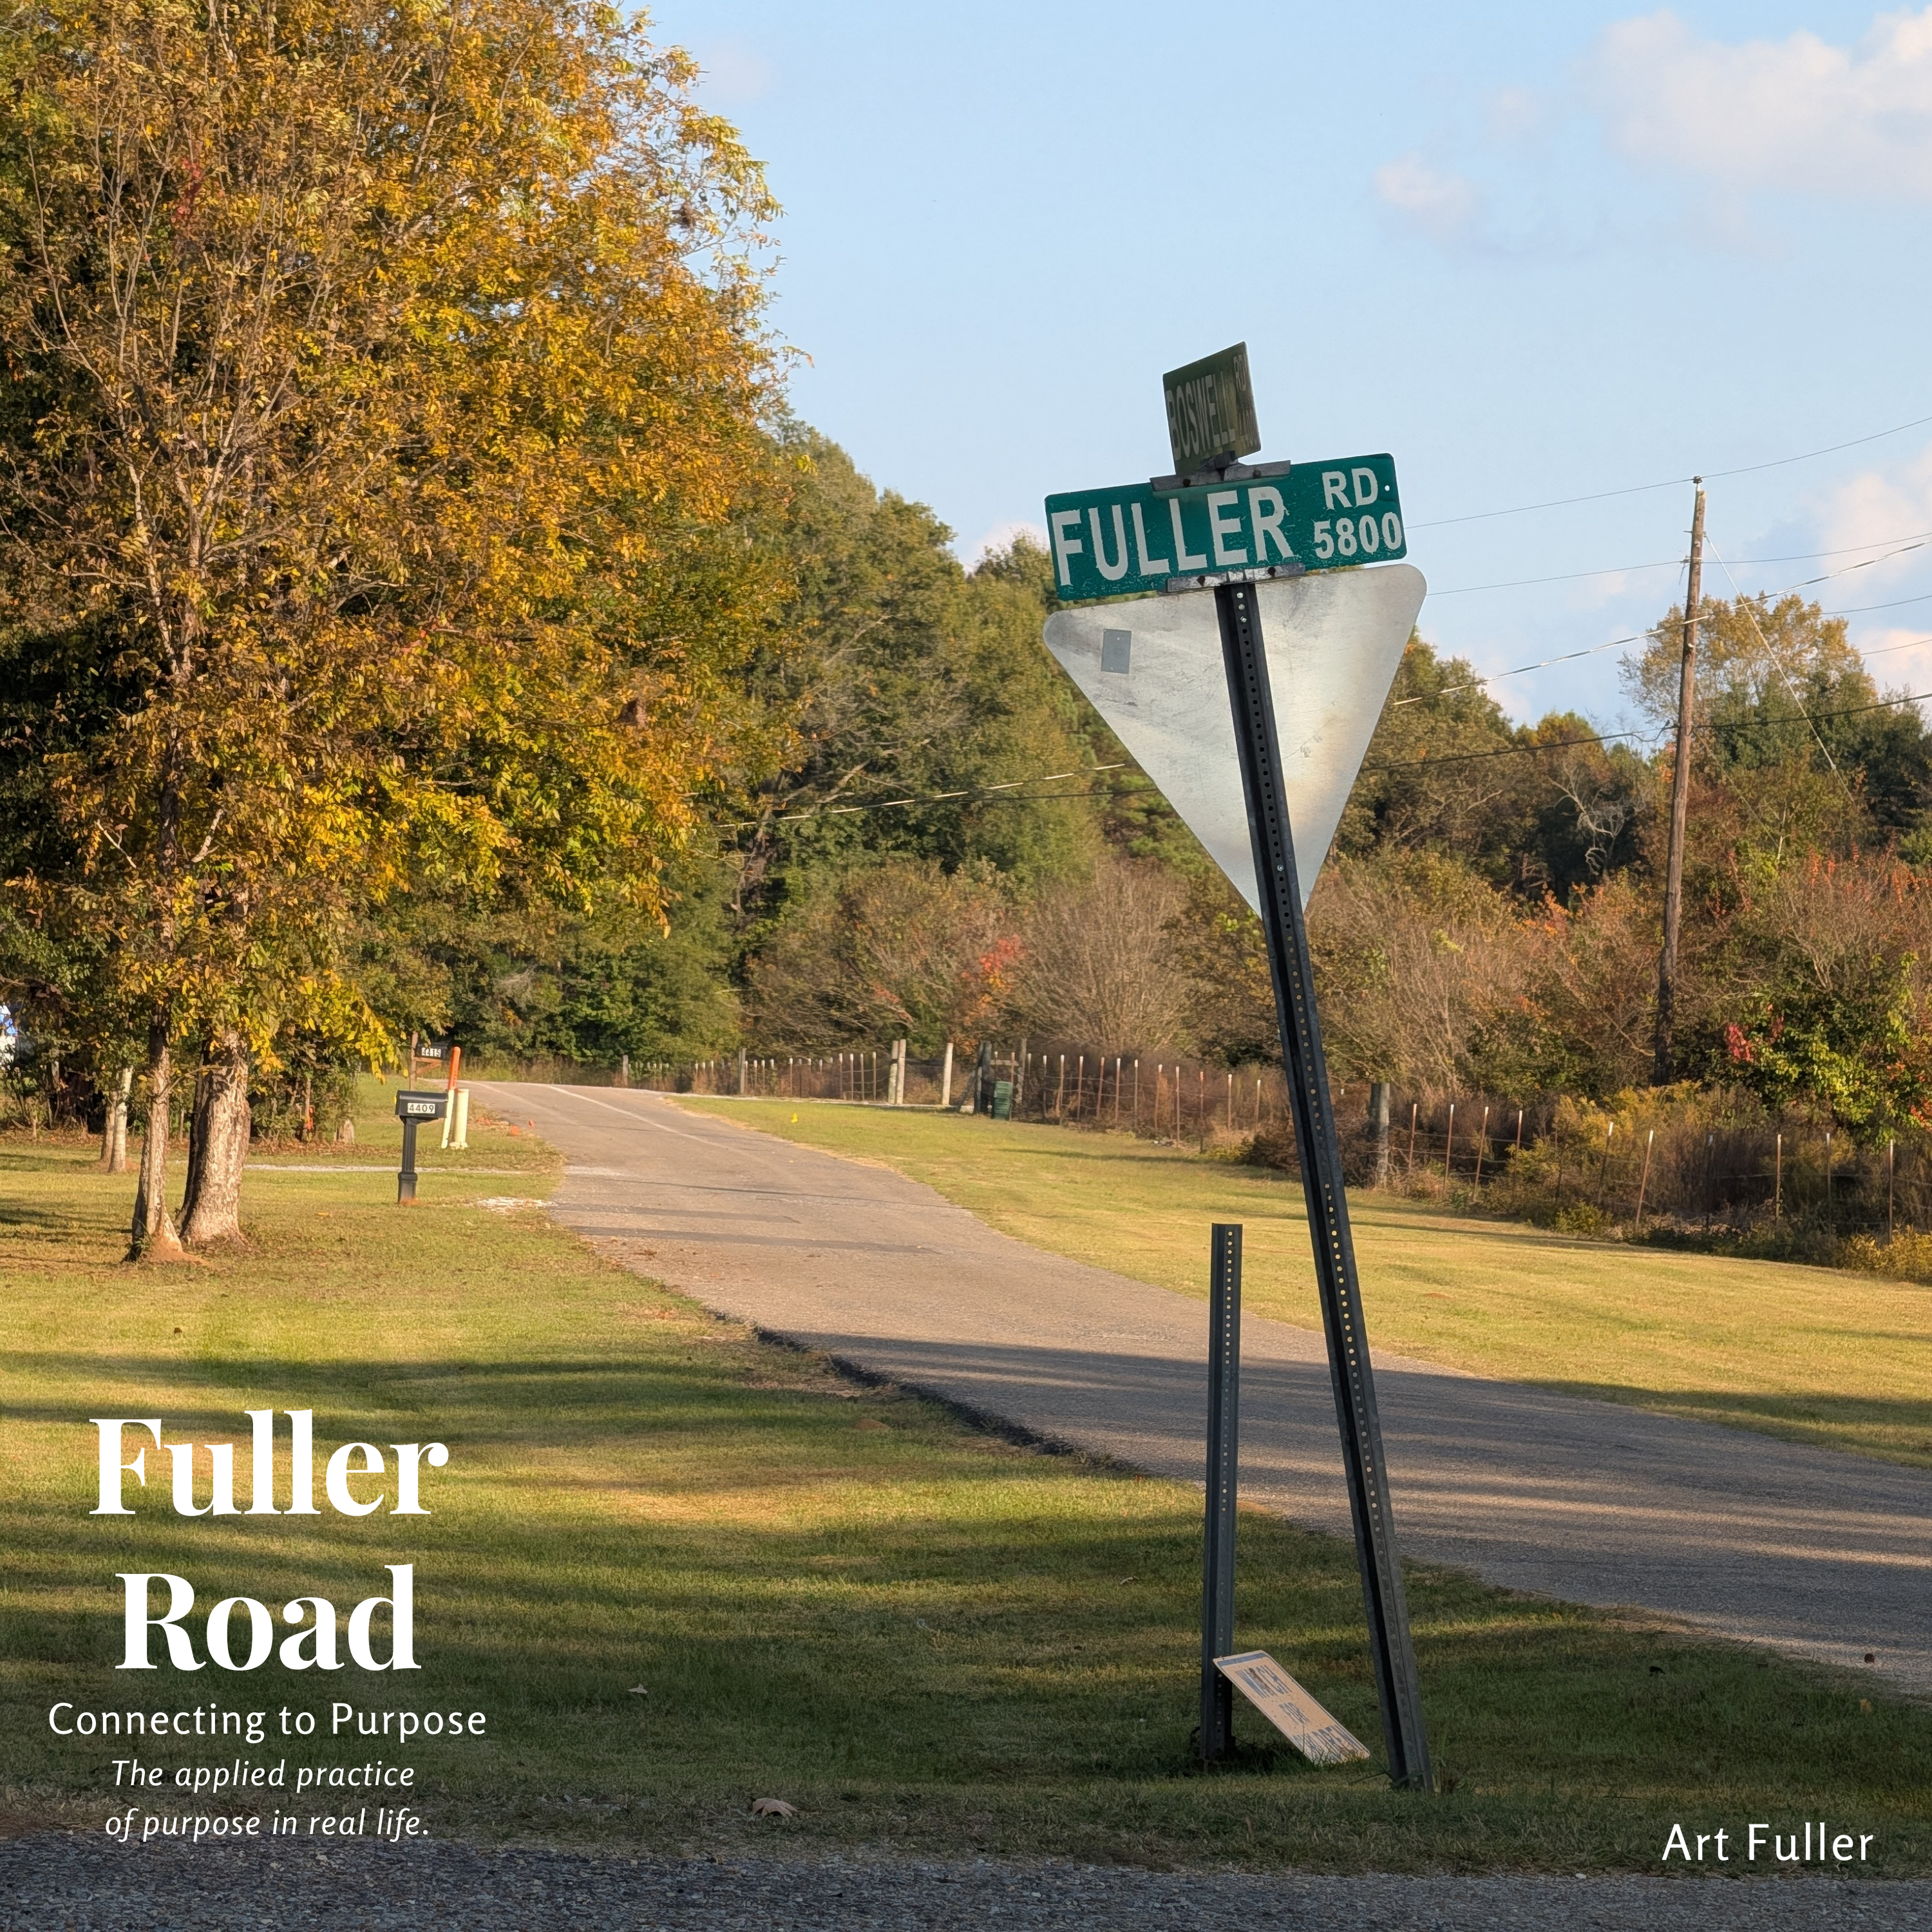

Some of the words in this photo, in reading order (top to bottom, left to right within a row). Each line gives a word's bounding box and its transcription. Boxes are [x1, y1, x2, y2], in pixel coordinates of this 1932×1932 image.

[1166, 371, 1236, 460] BOSWELL
[1233, 354, 1247, 392] RD
[1051, 486, 1294, 586] FULLER
[1321, 468, 1379, 511] RD
[1313, 512, 1402, 560] 5800
[409, 1103, 435, 1113] 4409
